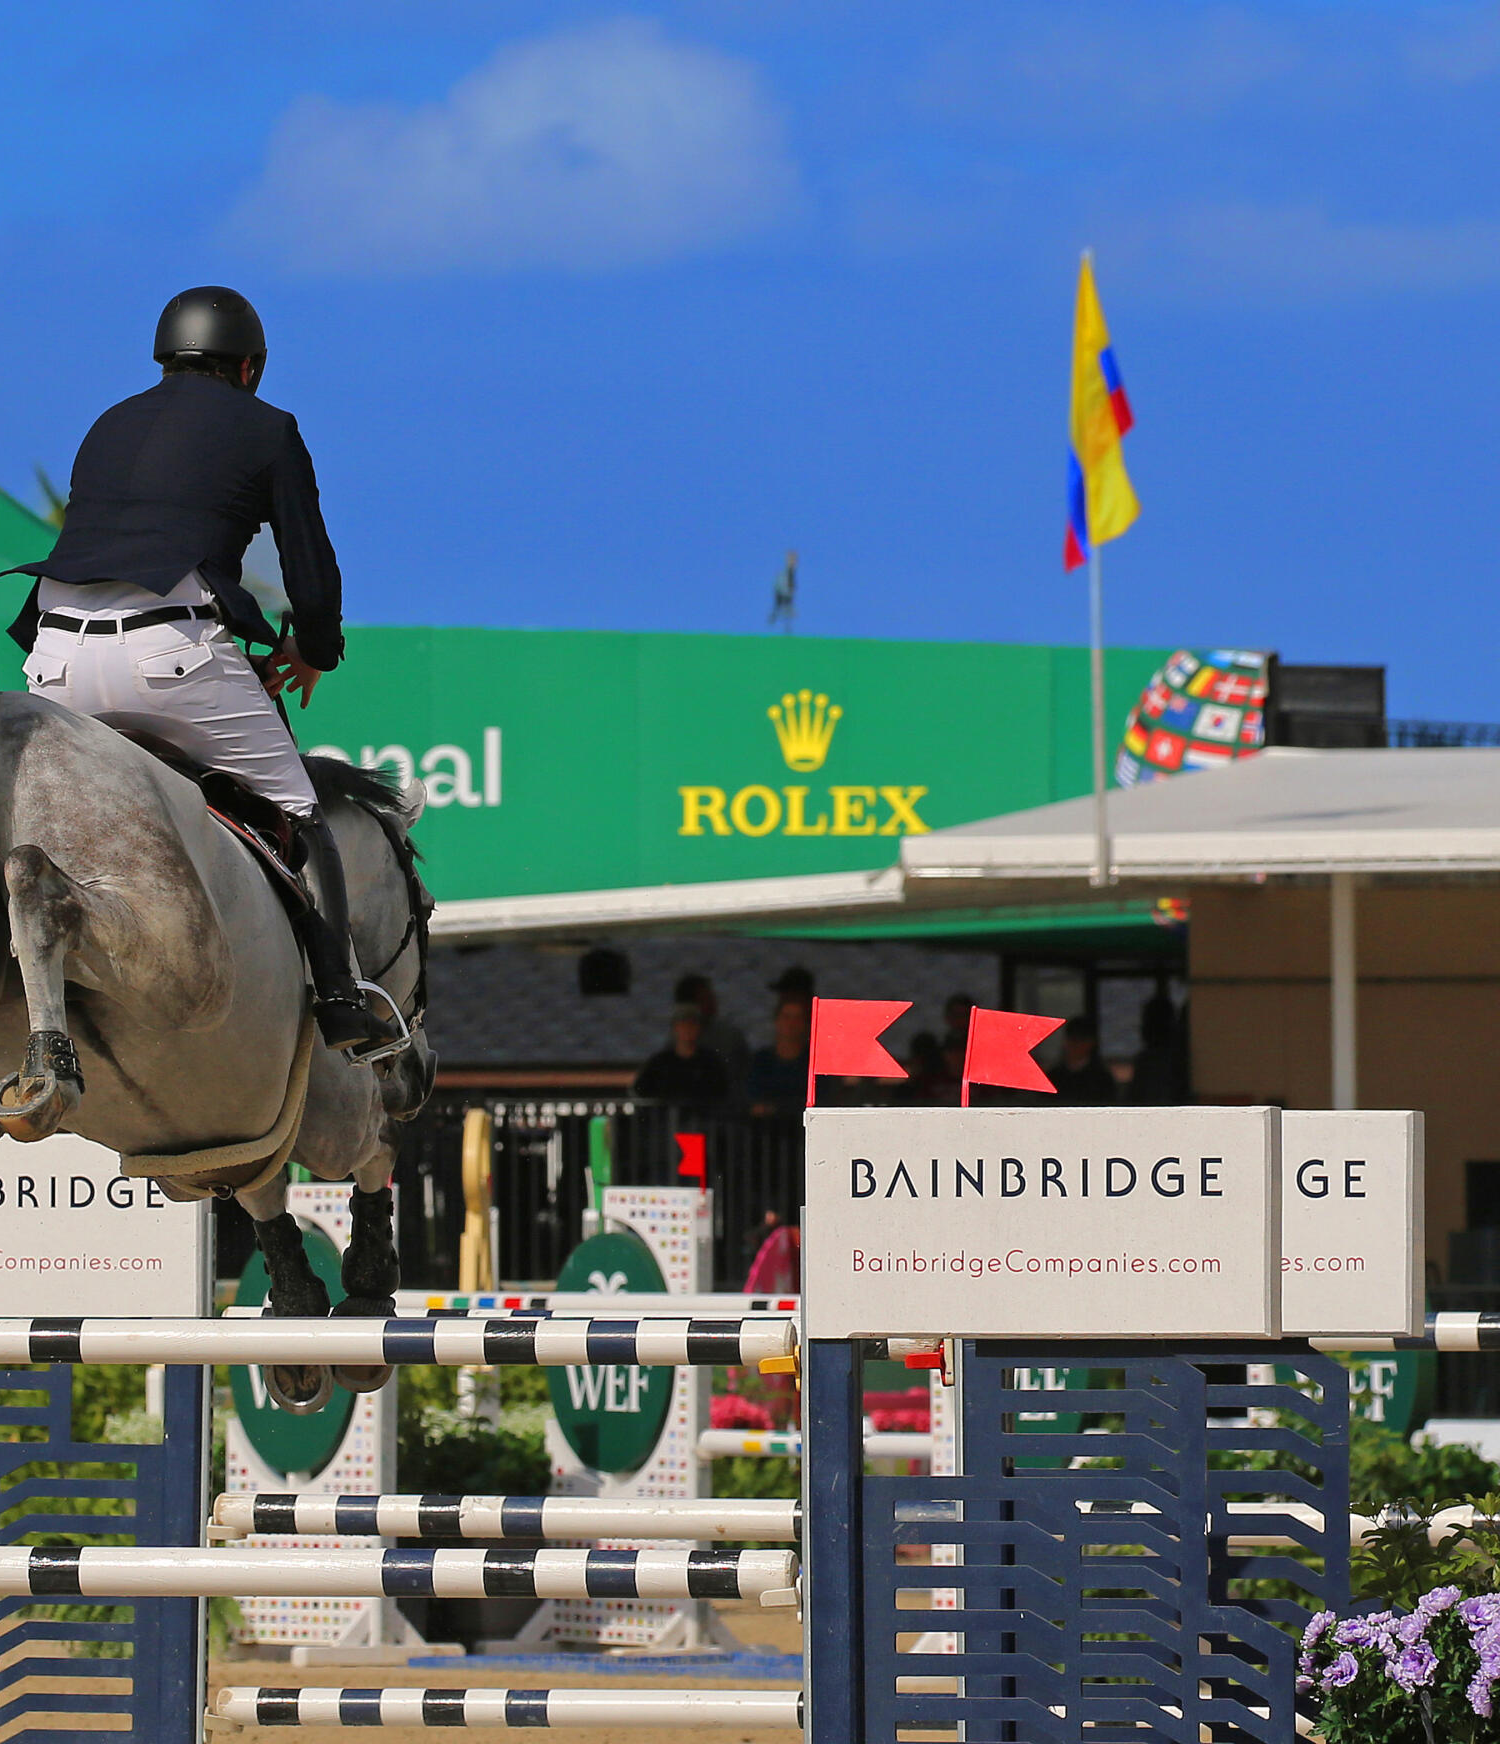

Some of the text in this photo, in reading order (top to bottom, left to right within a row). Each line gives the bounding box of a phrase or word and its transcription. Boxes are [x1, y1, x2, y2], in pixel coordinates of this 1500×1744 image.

[303, 725, 503, 808] nal
[678, 785, 930, 837] ROLEX
[850, 1156, 1224, 1199] BAINBRIDGE
[852, 1247, 1222, 1279] BainbridgeCompanies.com
[564, 1364, 653, 1413] WEF
